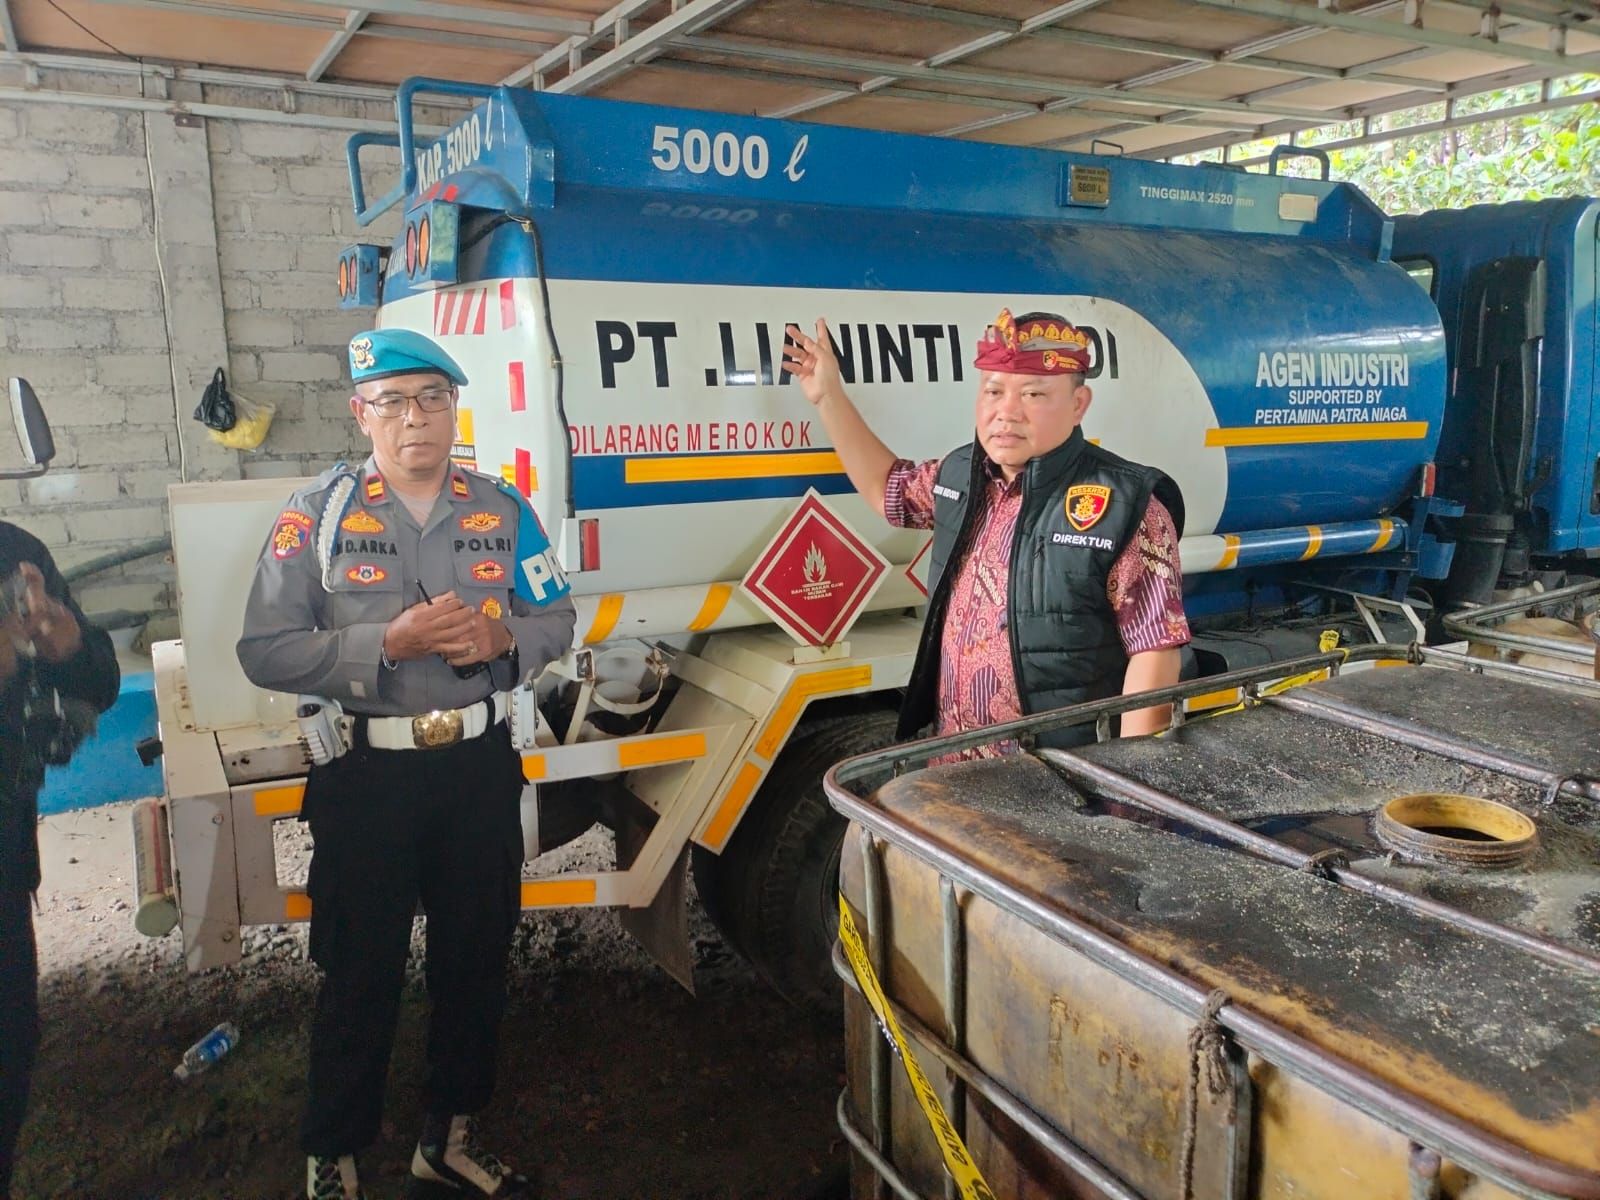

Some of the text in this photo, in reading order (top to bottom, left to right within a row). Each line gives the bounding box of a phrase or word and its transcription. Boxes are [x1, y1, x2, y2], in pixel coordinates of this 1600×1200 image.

[417, 142, 444, 195] KAP.
[446, 113, 480, 174] 5000
[652, 125, 769, 178] 5000
[1140, 186, 1254, 207] TINGGIMAX 2520 mm
[596, 321, 677, 388] PT
[1255, 352, 1409, 388] AGEN INDUSTRI
[1288, 389, 1382, 405] SUPPORTED BY
[1255, 407, 1407, 425] PERTAMINA PATRA NIAGA
[569, 423, 679, 454] DILARANG
[454, 538, 511, 552] POLRI
[1053, 533, 1113, 550] DIREKTUR
